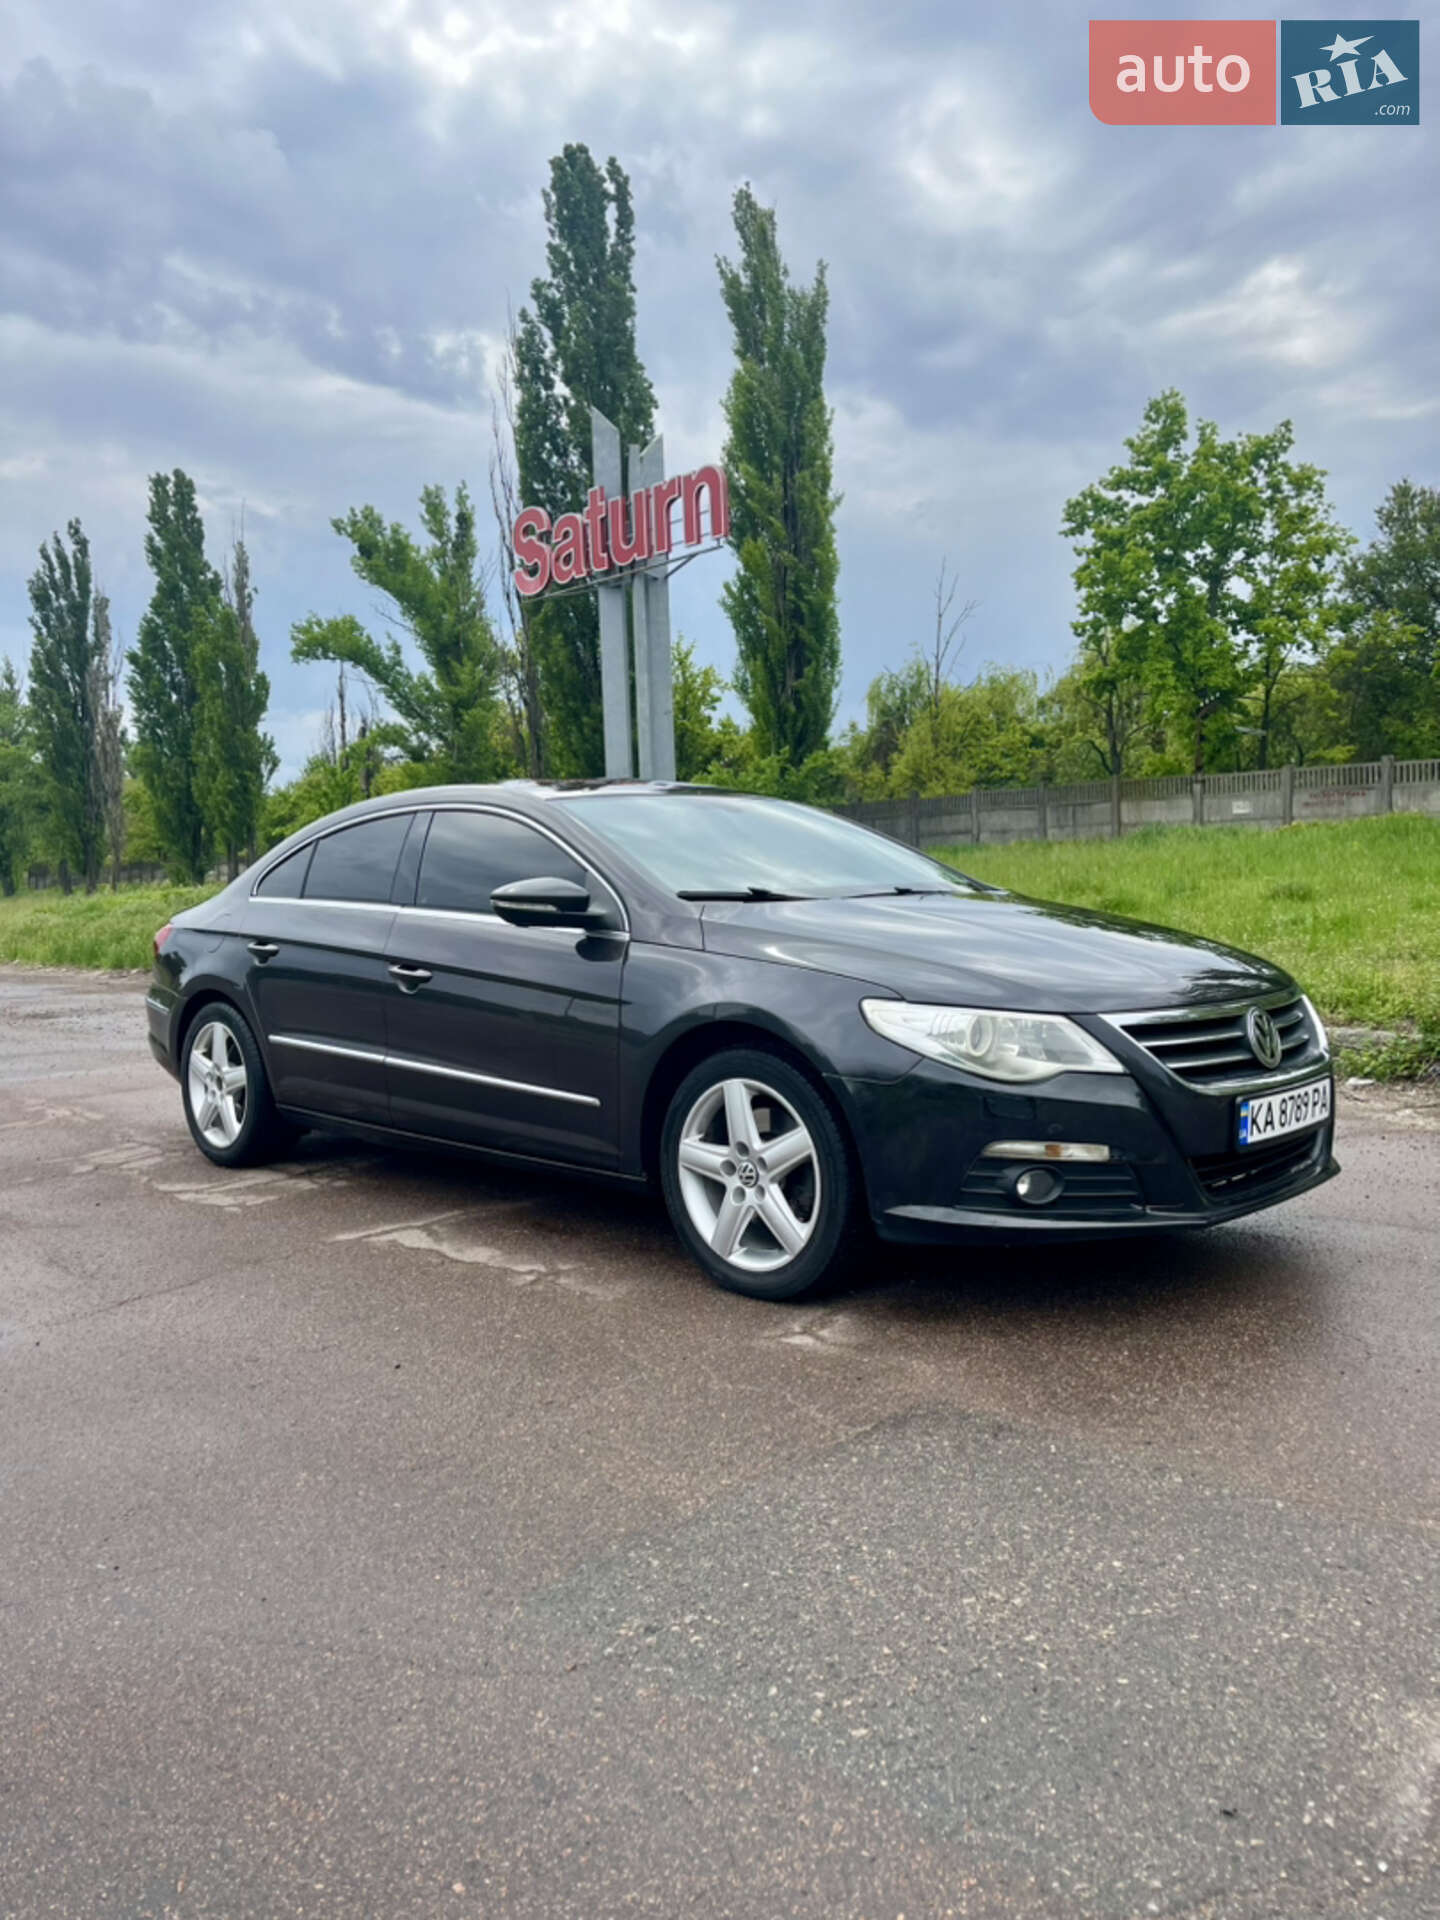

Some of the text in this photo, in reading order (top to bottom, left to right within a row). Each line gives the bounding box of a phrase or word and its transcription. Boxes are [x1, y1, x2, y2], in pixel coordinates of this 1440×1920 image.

[513, 465, 728, 596] Saturn
[1250, 1085, 1328, 1137] KA 8789 PA
